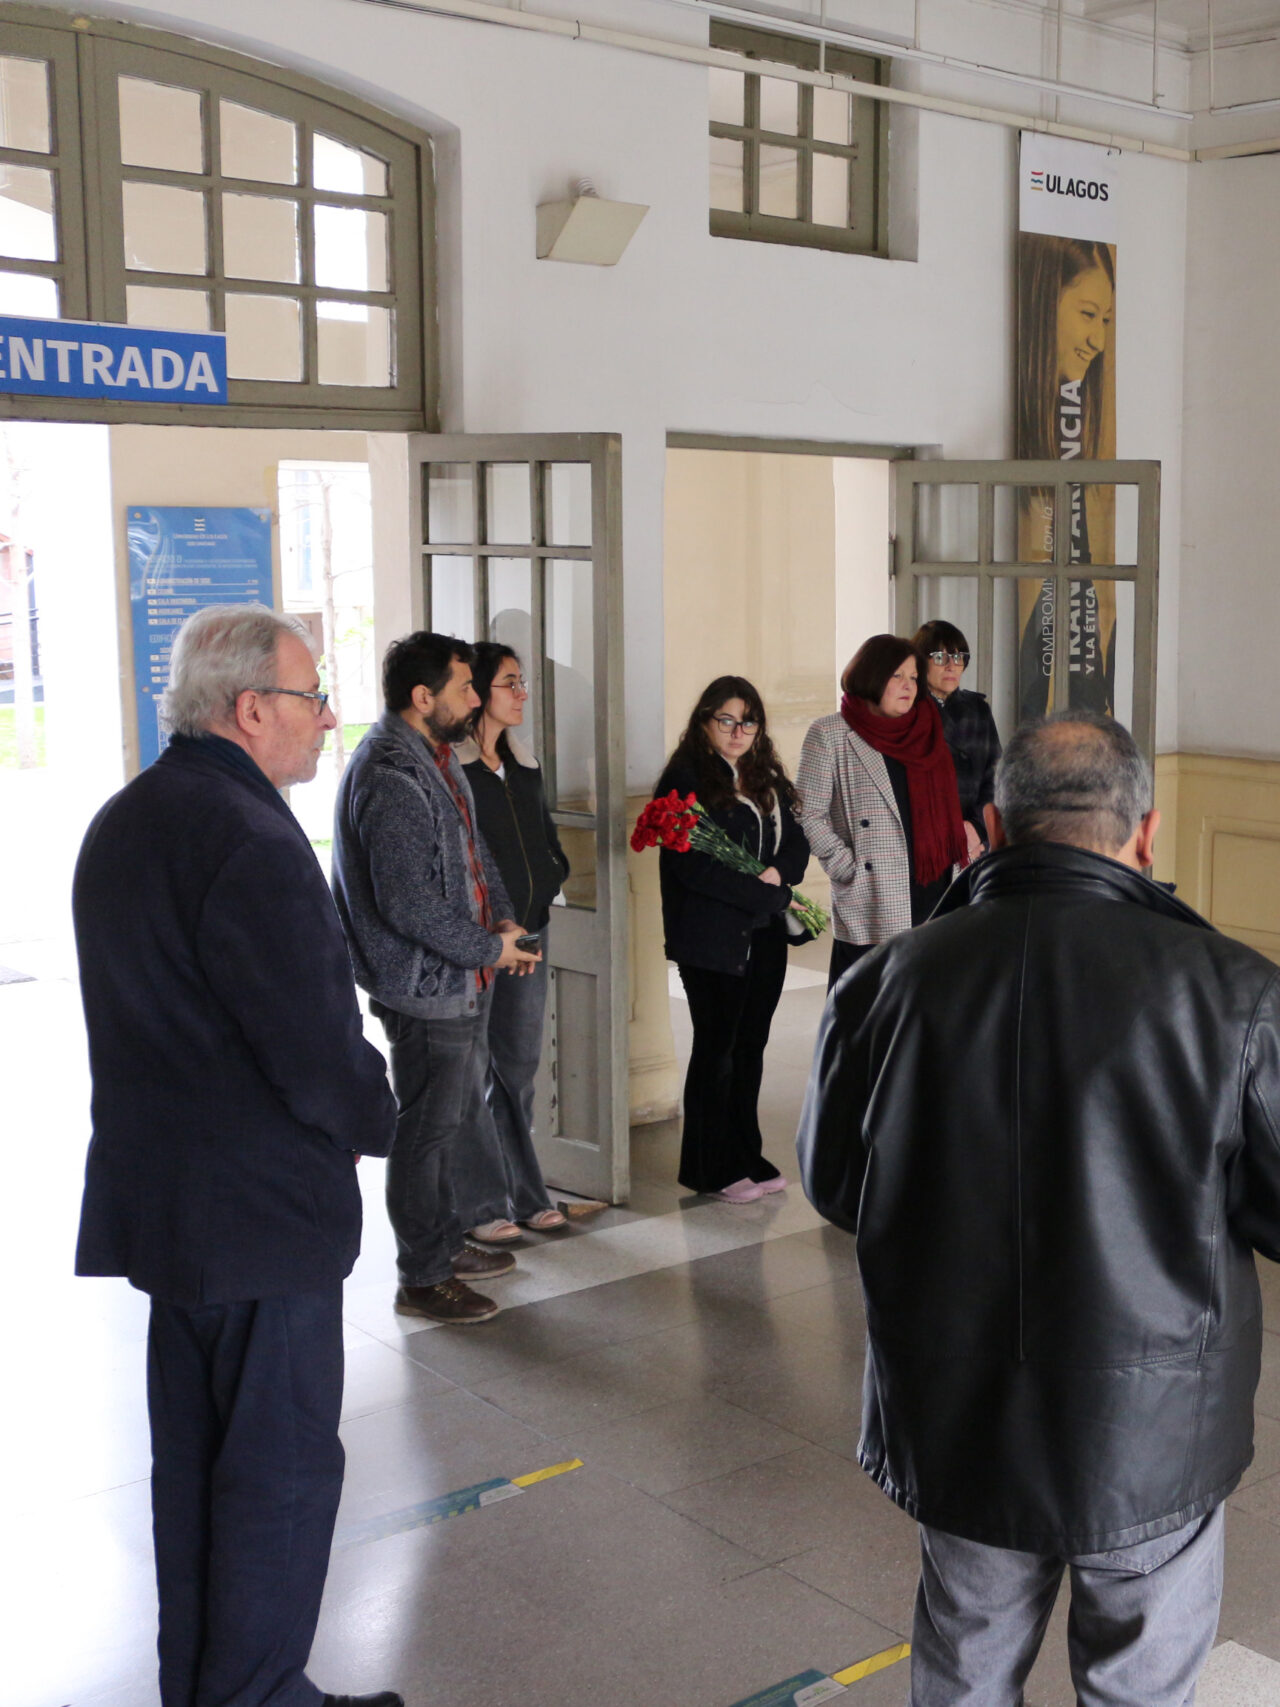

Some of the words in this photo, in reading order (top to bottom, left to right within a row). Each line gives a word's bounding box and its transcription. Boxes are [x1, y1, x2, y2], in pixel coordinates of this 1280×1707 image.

[1046, 174, 1109, 201] ULAGOS
[0, 335, 220, 393] NTRADA
[1041, 506, 1054, 520] la
[1044, 525, 1054, 553] con
[1042, 559, 1054, 677] COMPROMI
[1083, 586, 1096, 633] ÉTICA
[1085, 638, 1096, 659] LA
[1085, 663, 1095, 675] Y
